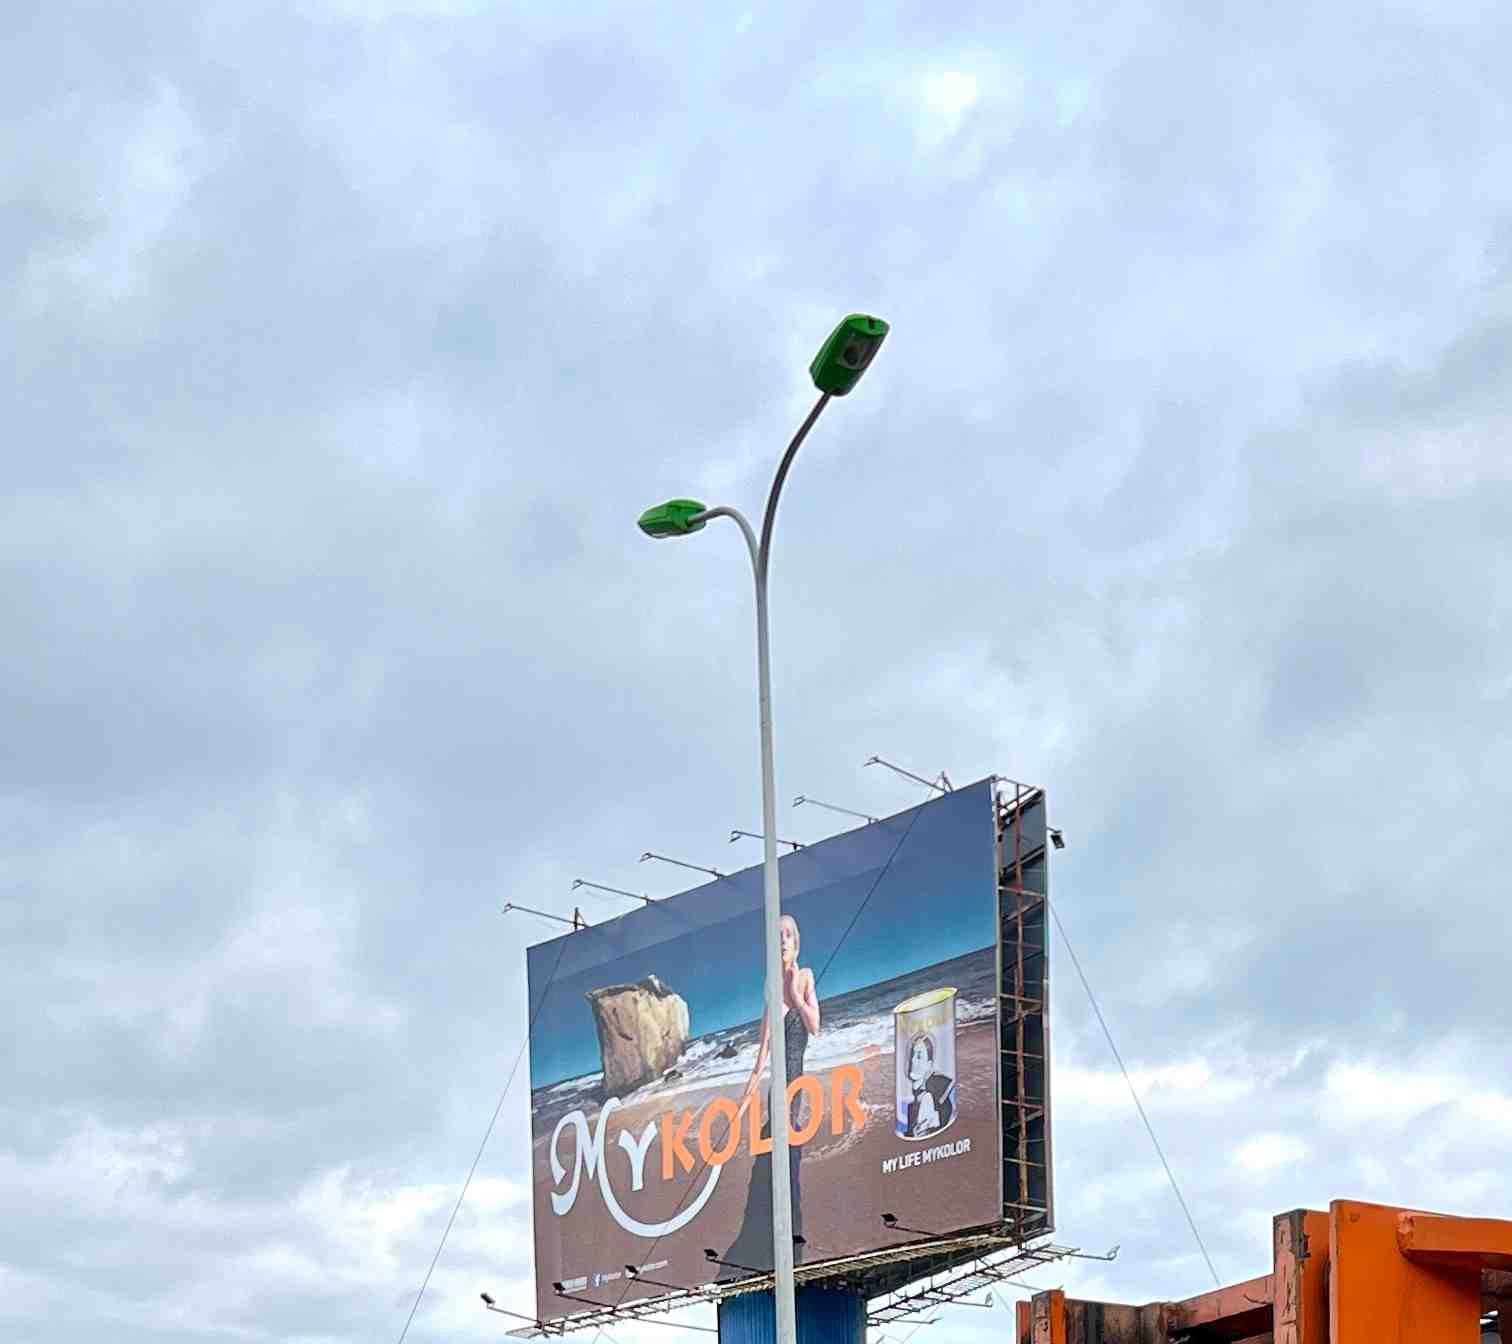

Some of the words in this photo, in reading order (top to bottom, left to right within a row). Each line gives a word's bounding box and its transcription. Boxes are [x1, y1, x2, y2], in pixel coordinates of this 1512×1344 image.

[882, 1158, 898, 1173] MY
[899, 1151, 921, 1169] LIFE
[922, 1138, 971, 1164] MYKOLOR
